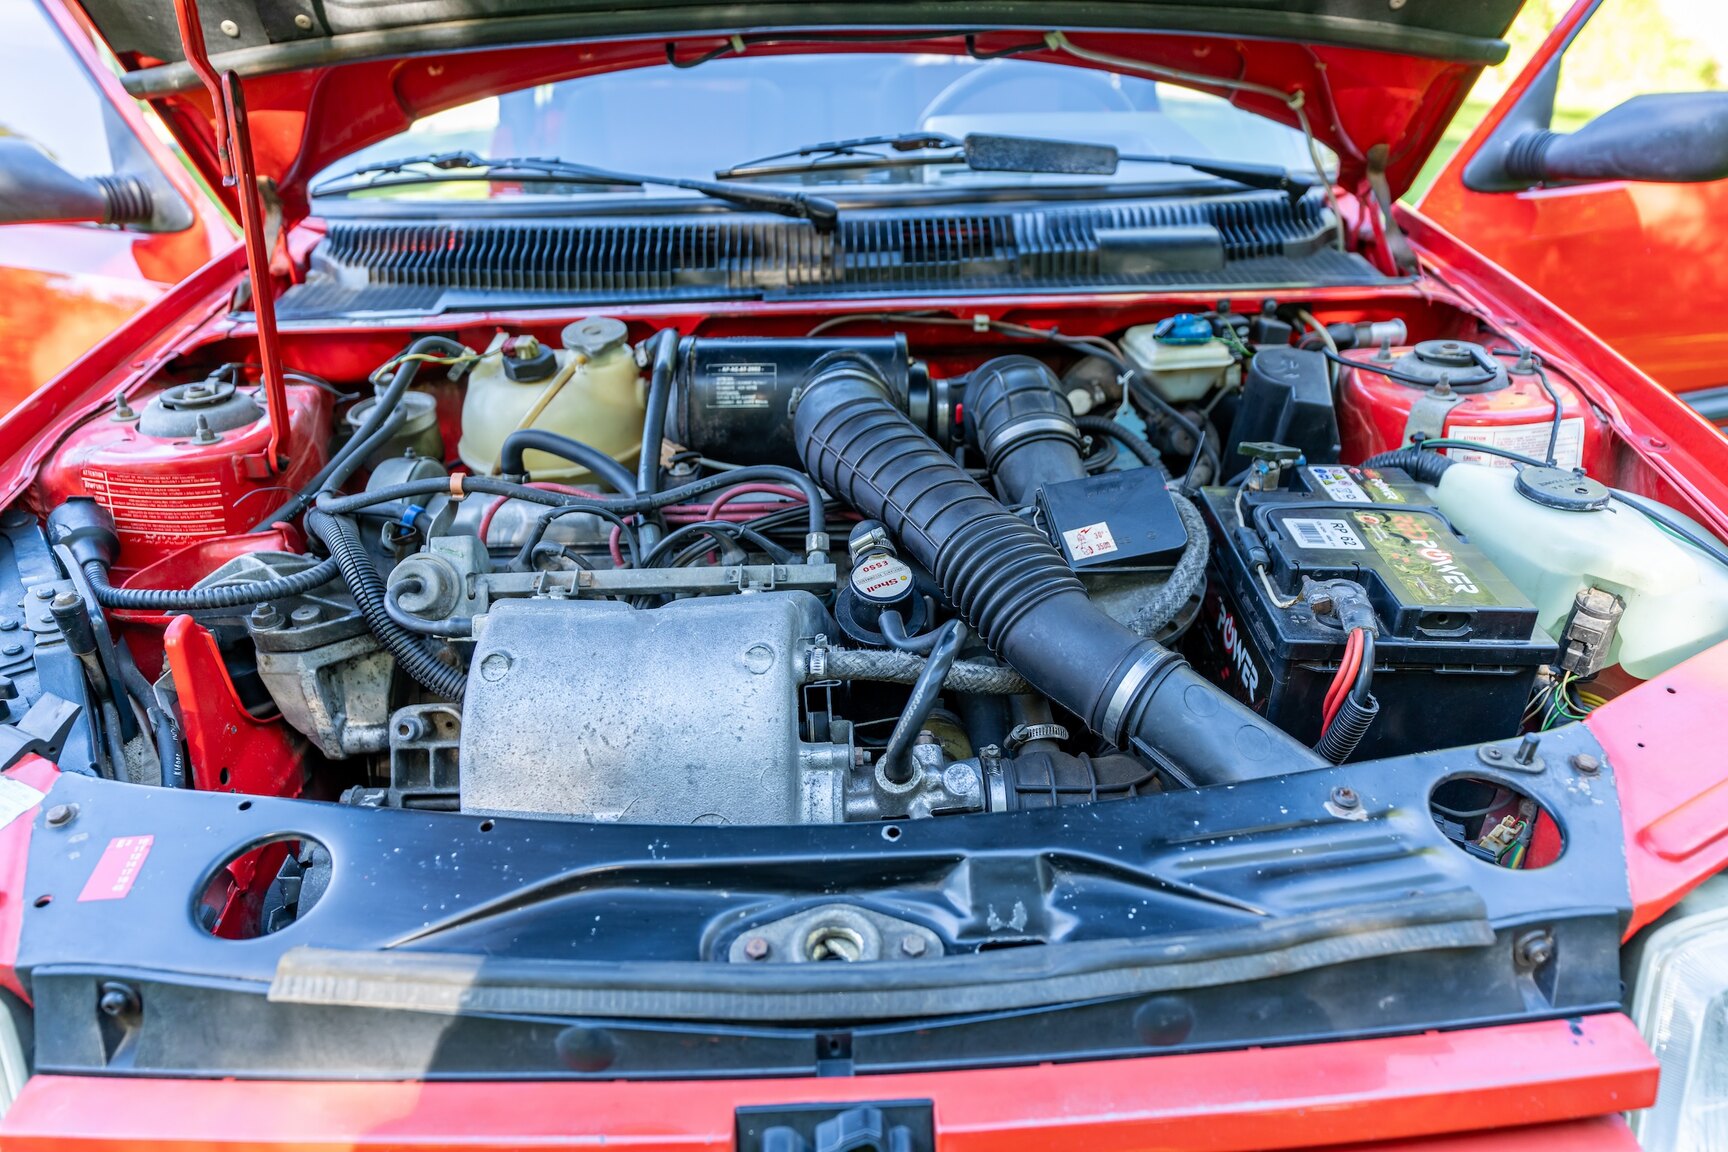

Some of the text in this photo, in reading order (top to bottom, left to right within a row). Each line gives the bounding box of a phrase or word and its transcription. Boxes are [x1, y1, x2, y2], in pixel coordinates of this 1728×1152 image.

[1330, 522, 1357, 546] RP 62
[863, 560, 888, 573] ESSO
[1410, 540, 1479, 594] POWER
[867, 578, 898, 593] Shell
[1217, 597, 1259, 702] POWER
